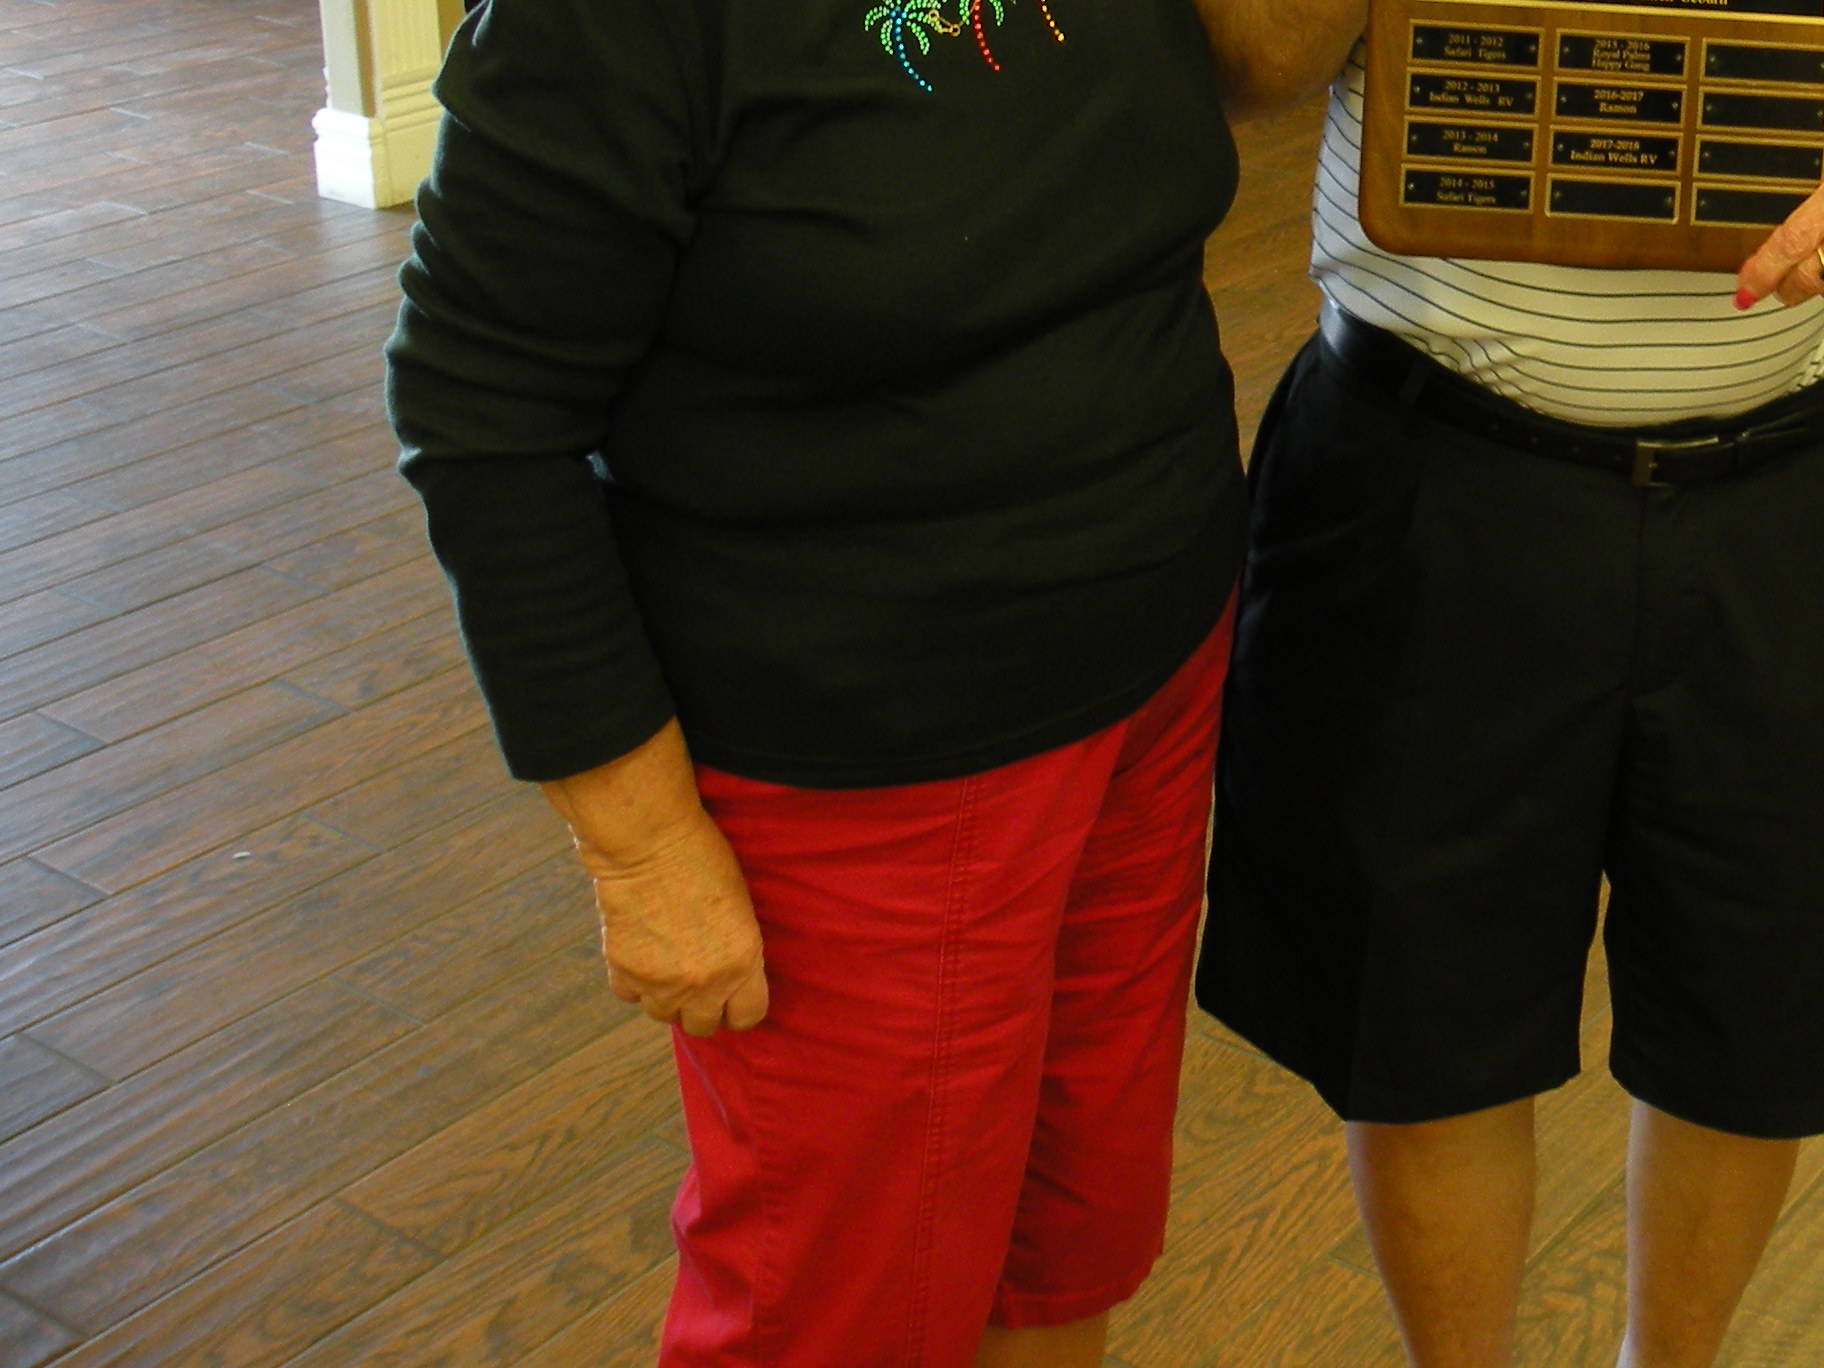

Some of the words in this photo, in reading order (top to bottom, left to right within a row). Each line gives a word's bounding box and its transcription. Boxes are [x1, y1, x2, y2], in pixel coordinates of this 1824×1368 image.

[1498, 96, 1514, 107] RV
[1570, 149, 1606, 162] Indian
[1608, 151, 1638, 163] Wells
[1640, 153, 1658, 165] RV
